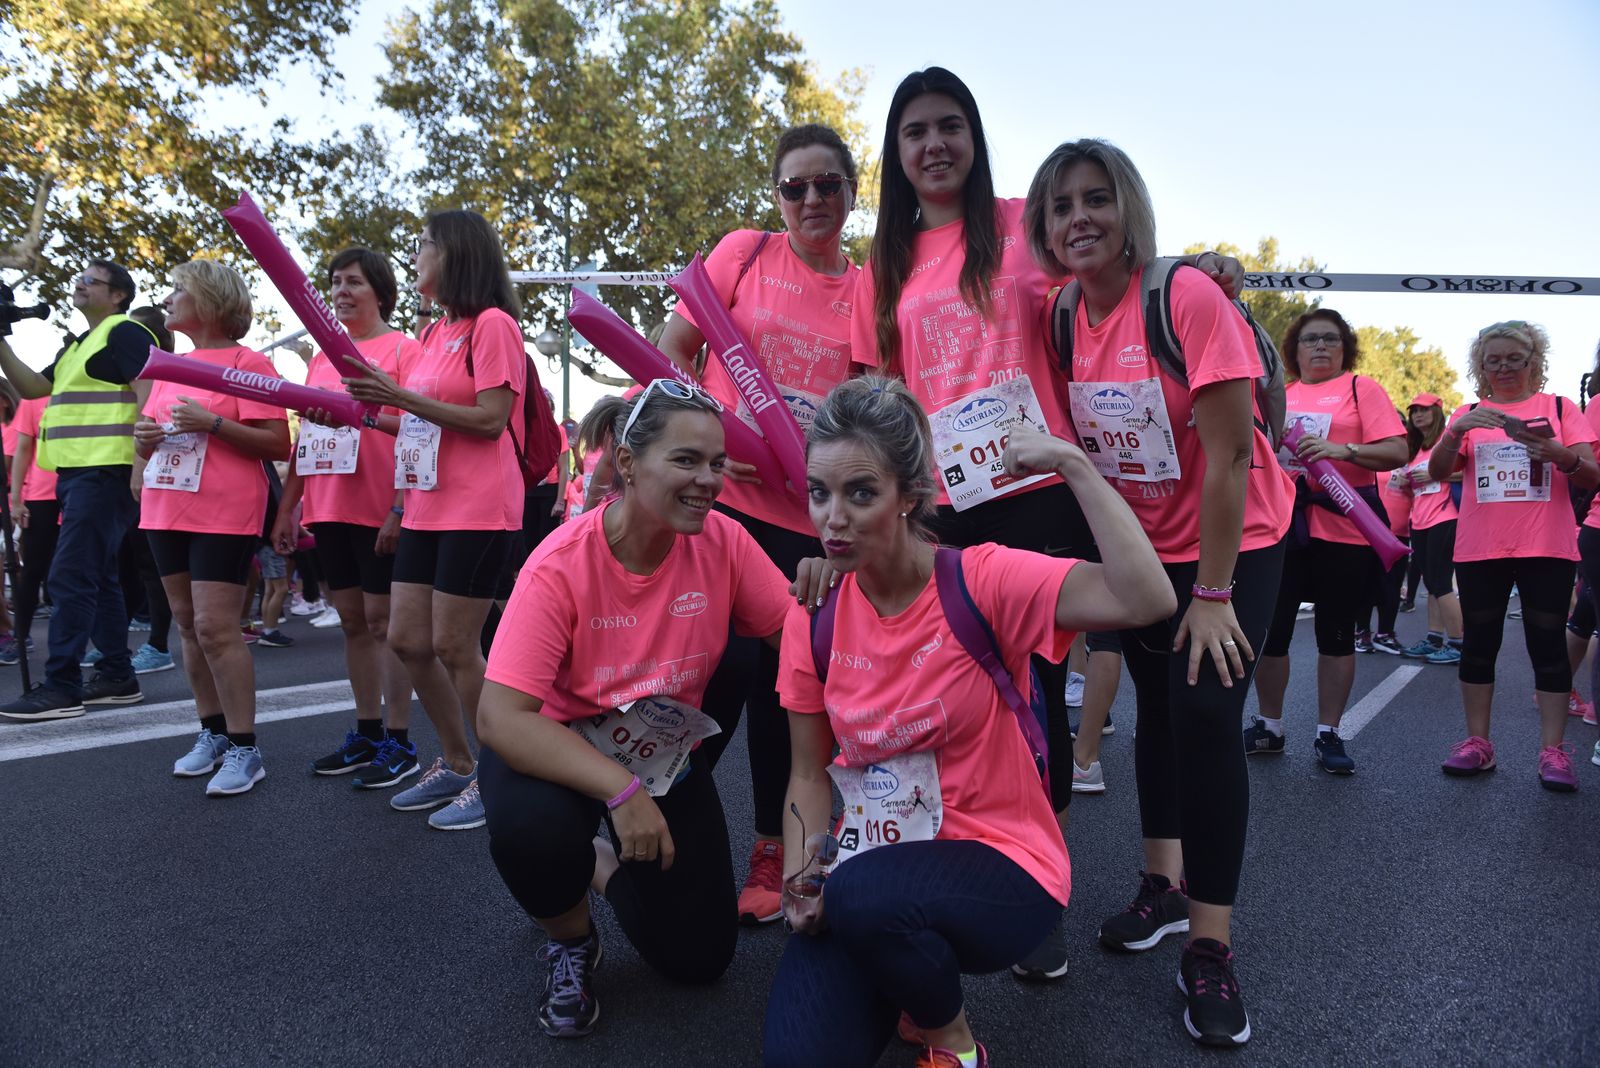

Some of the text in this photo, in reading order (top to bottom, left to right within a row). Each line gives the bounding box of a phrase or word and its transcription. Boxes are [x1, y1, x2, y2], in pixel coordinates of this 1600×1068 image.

[760, 275, 802, 295] OYSHO
[782, 335, 809, 350] VITORIA
[222, 367, 289, 392] Ladival
[721, 342, 777, 414] Ladival
[1093, 399, 1131, 410] ASTURIANA
[957, 405, 1004, 429] ASTURIANA
[311, 438, 336, 451] 016
[1102, 431, 1140, 449] 016
[400, 448, 420, 462] 016
[1118, 451, 1133, 460] 448
[990, 461, 1003, 473] 45
[1497, 470, 1528, 481] 016
[956, 486, 983, 502] OYSHO
[591, 615, 637, 629] OYSHO
[633, 668, 700, 693] VITORIA GASTEIZ
[895, 718, 932, 736] GASTEIZ
[612, 726, 658, 759] 016
[613, 751, 633, 766] 489
[881, 799, 906, 809] Carrera
[866, 819, 901, 844] 016
